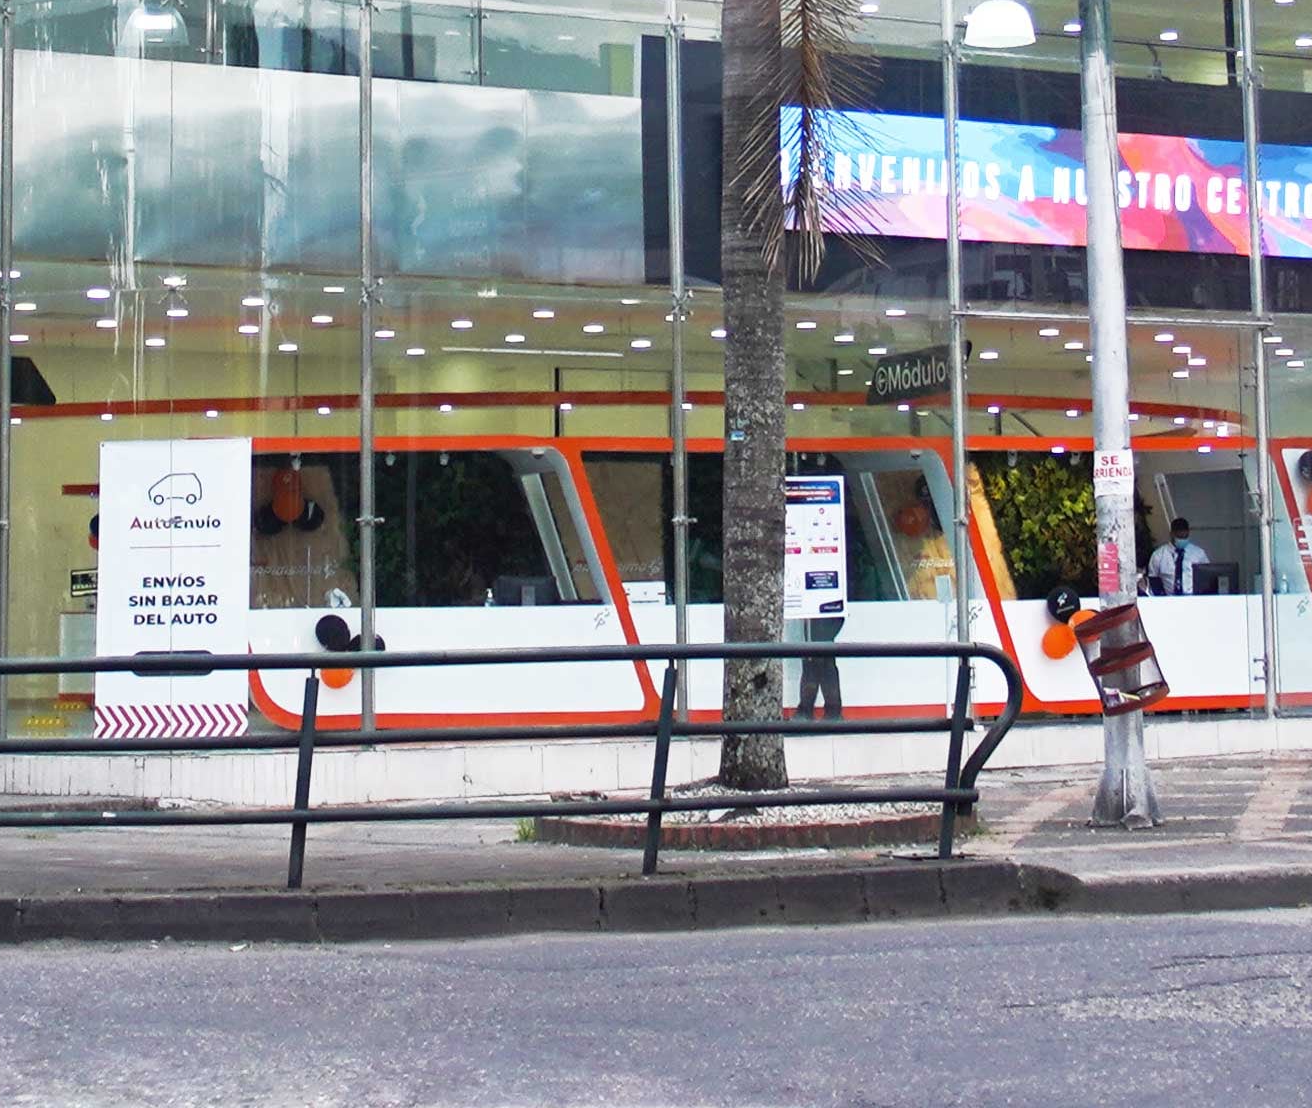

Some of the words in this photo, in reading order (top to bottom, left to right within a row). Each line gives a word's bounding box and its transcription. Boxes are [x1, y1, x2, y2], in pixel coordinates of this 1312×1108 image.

[1017, 164, 1035, 202] A
[1052, 166, 1192, 214] NUSTRO
[888, 356, 946, 393] Módulo
[1101, 455, 1119, 466] SE
[142, 572, 206, 588] ENVÍOS
[128, 595, 156, 607] SIN
[162, 594, 219, 607] BAJAR
[133, 614, 166, 625] DEL
[171, 613, 218, 625] AUTO
